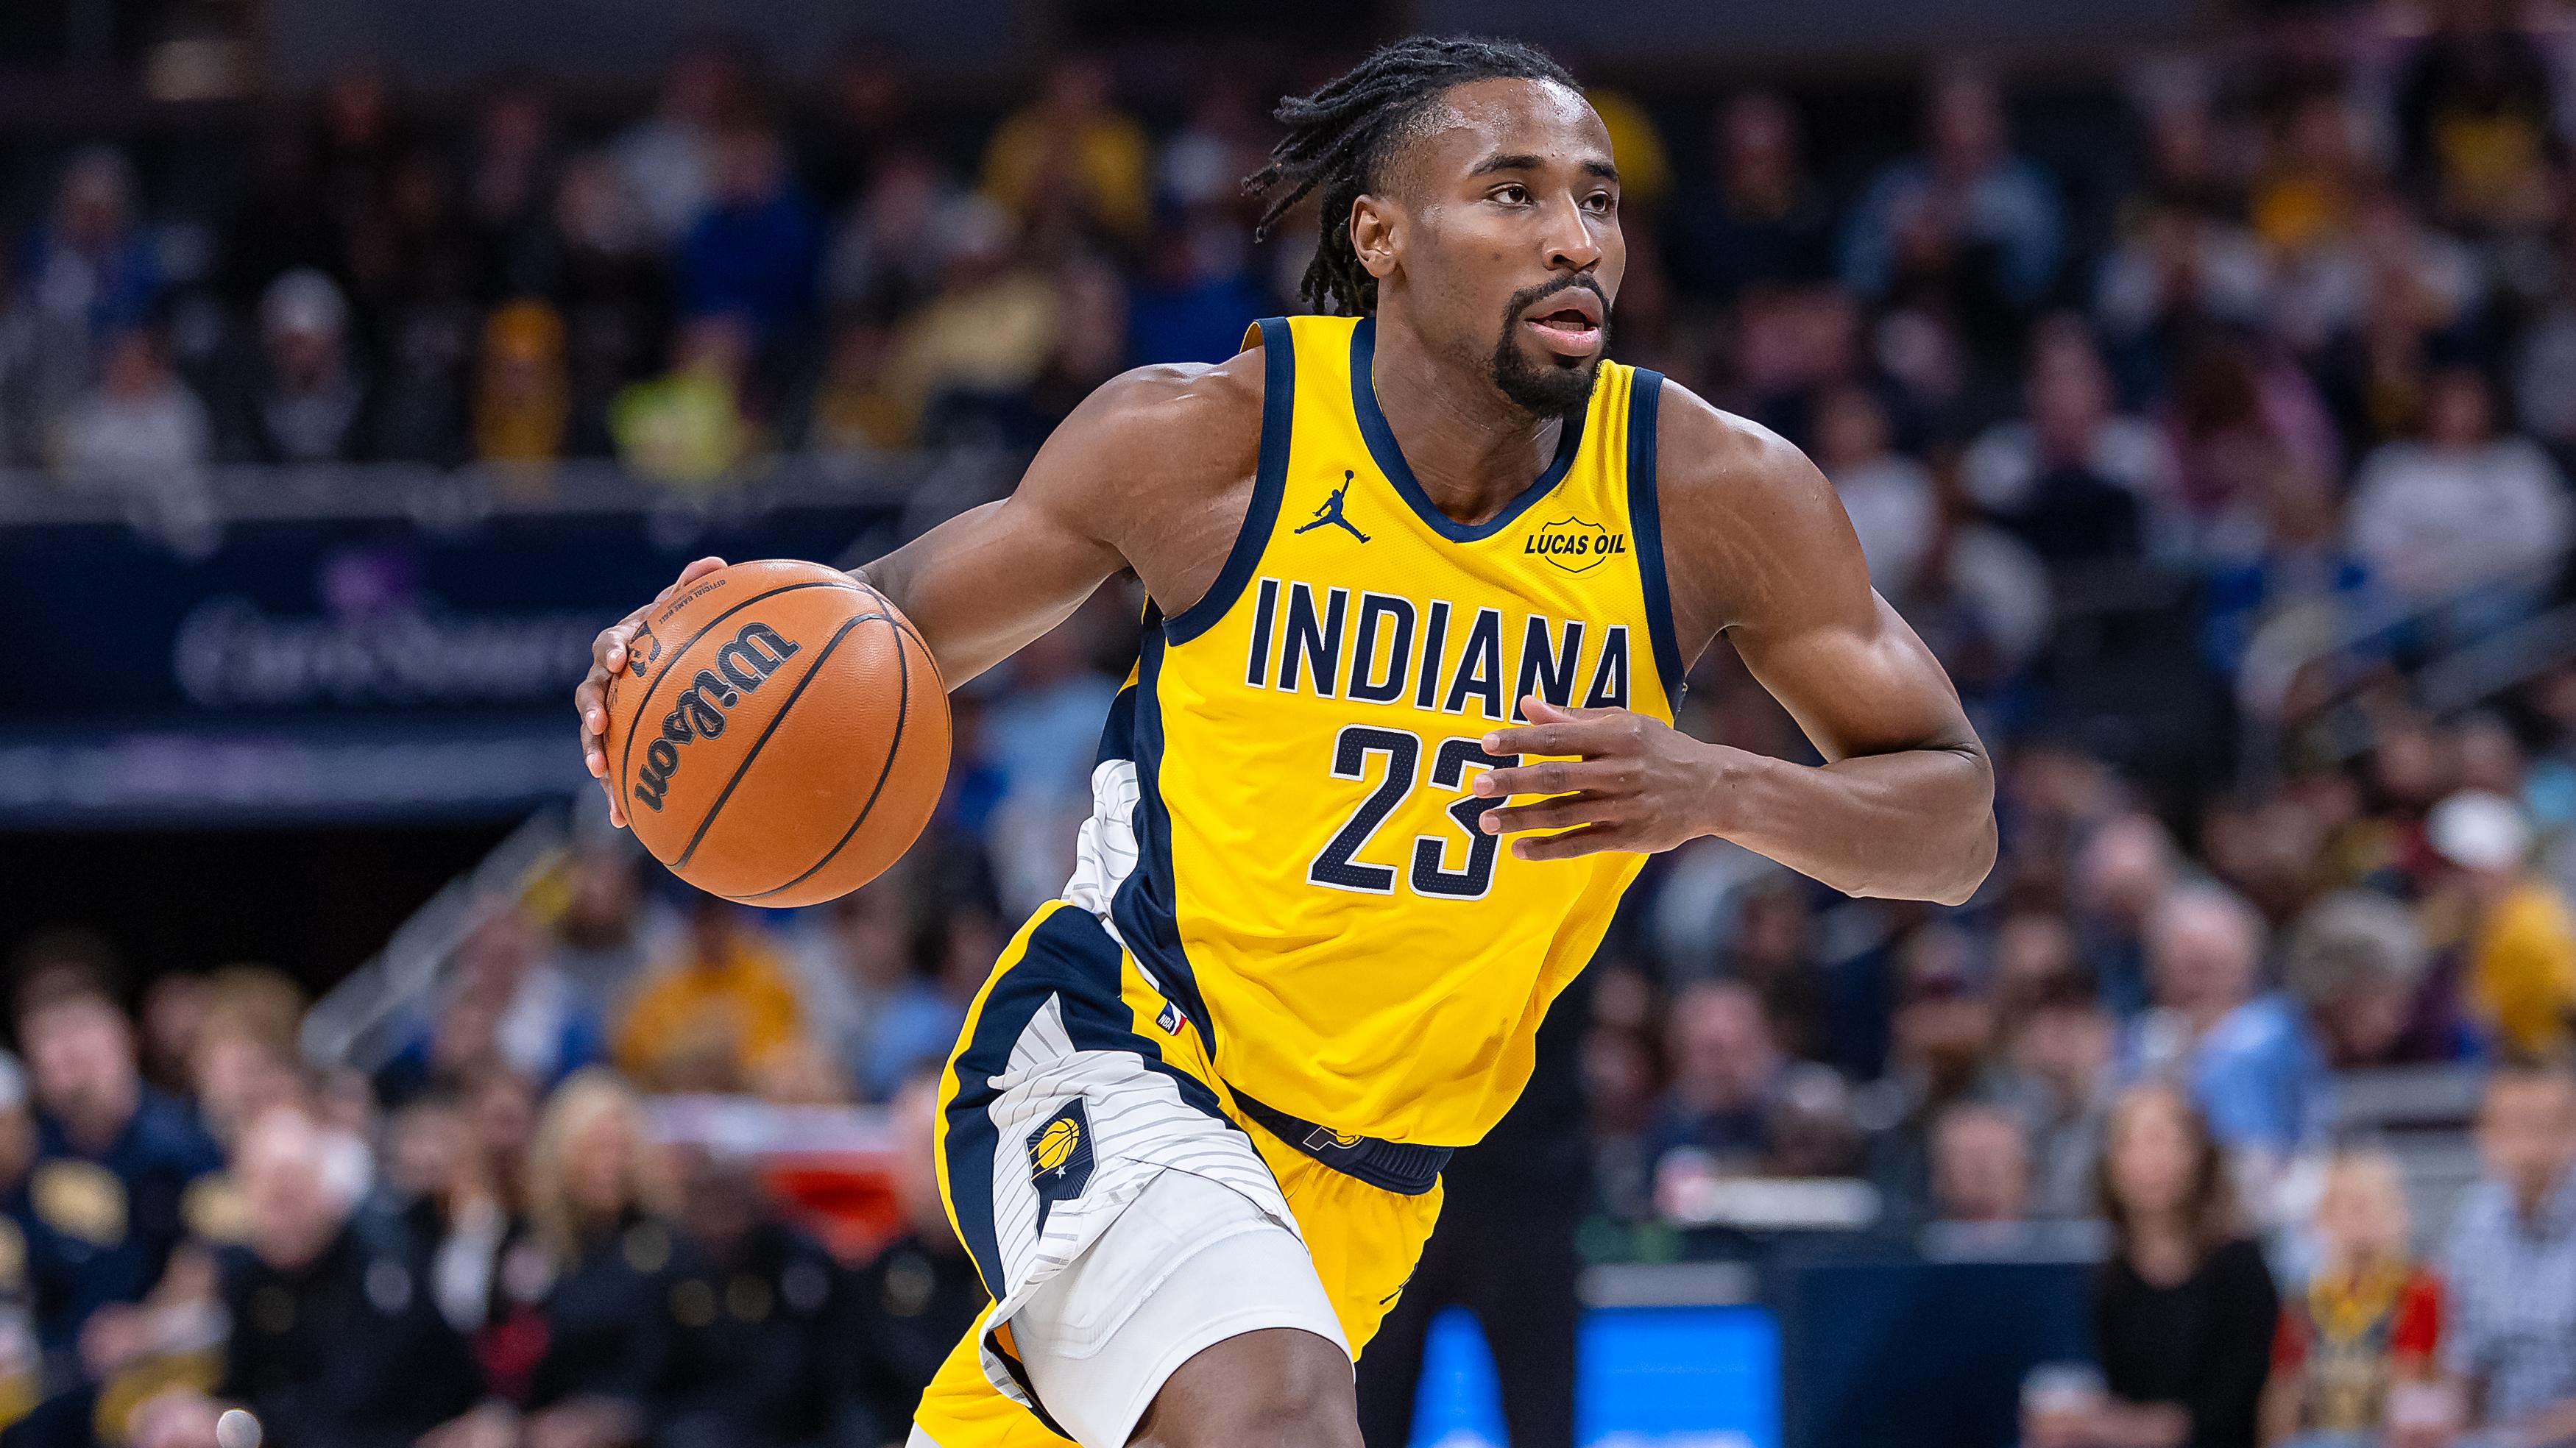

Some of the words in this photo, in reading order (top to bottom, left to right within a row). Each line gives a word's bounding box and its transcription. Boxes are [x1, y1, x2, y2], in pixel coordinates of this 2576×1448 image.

[1524, 534, 1588, 555] LUCAS
[1594, 534, 1626, 554] OIL
[694, 579, 726, 597] OFFICIAL
[674, 597, 693, 611] GAME
[1246, 575, 1630, 725] INDIANA
[634, 622, 801, 812] Wilson
[1306, 723, 1523, 901] 23
[1158, 1014, 1174, 1030] NBA
